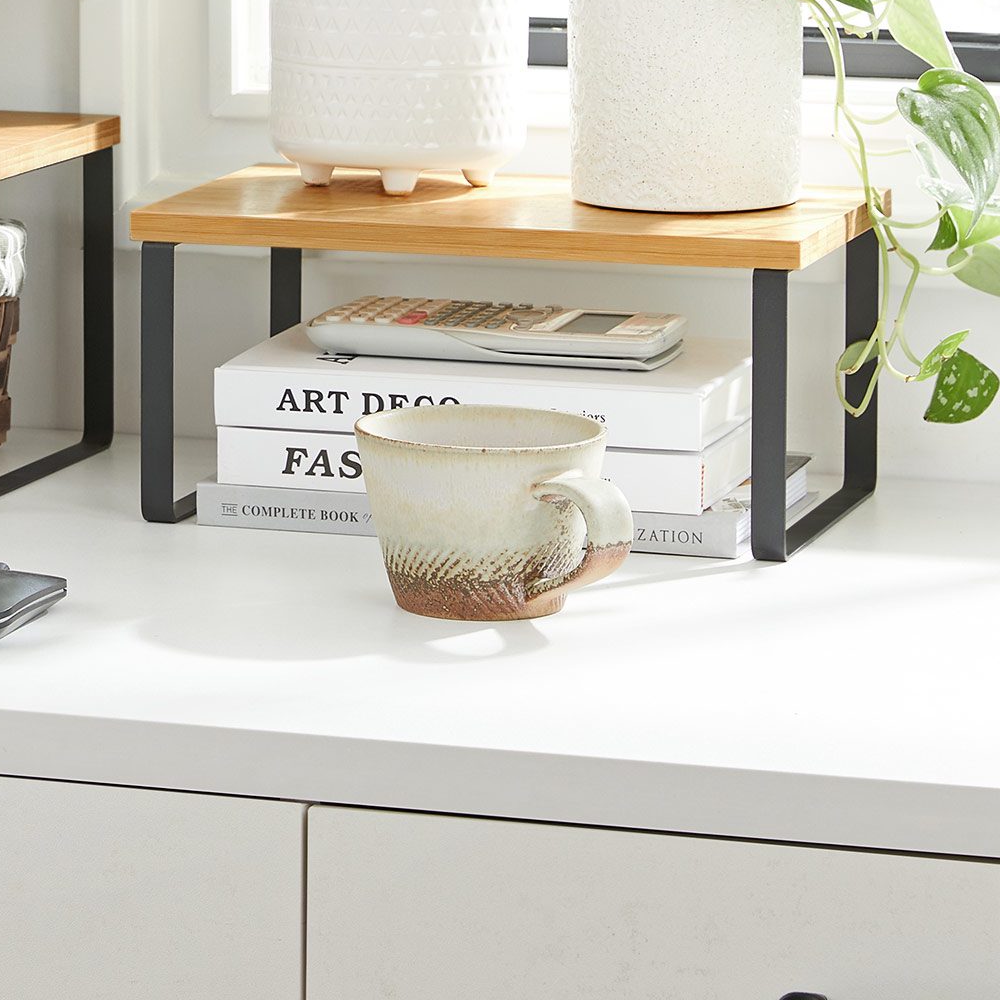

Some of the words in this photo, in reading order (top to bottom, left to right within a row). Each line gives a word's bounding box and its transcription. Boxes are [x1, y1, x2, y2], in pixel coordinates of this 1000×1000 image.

[276, 388, 349, 414] ART
[221, 504, 237, 514] THE
[242, 505, 316, 520] COMPLETE
[320, 510, 359, 523] BOOK
[633, 528, 703, 544] ZATION
